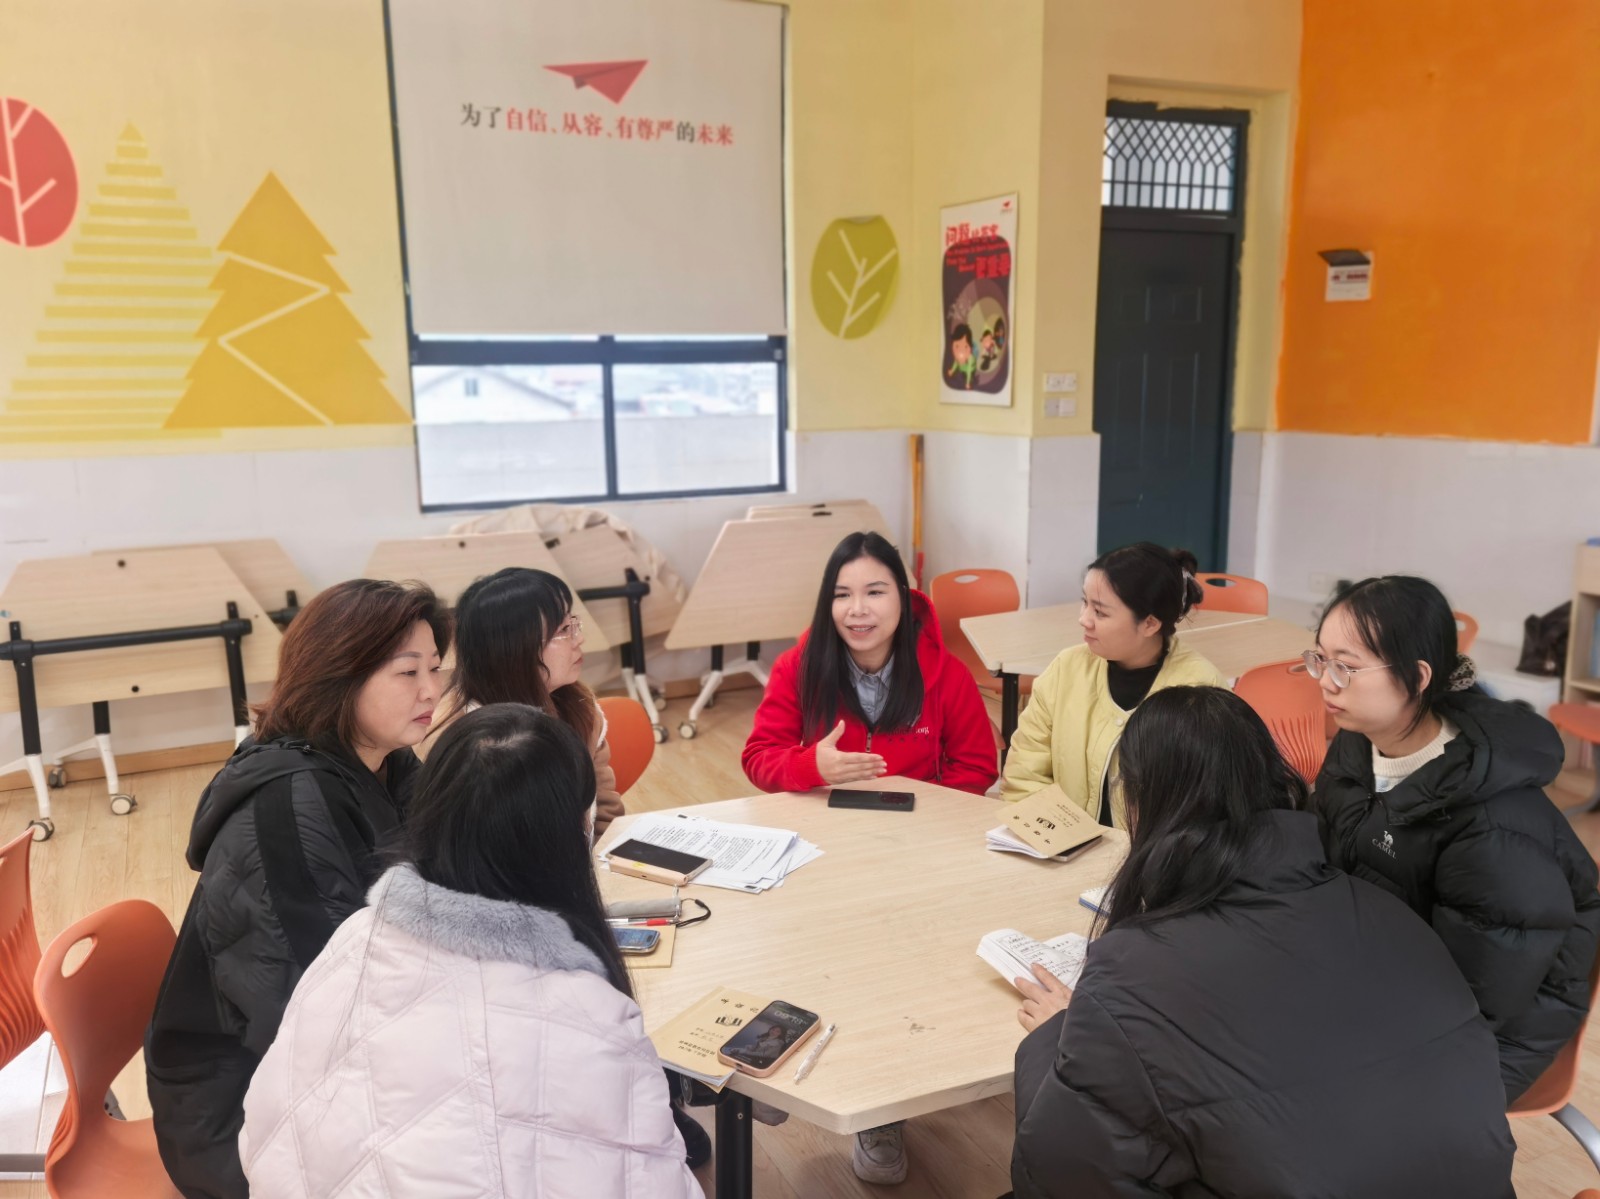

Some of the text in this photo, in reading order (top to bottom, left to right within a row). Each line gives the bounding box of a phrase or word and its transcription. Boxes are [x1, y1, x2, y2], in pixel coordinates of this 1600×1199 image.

[460, 103, 734, 145] 为了自信、从容、有尊严的未来
